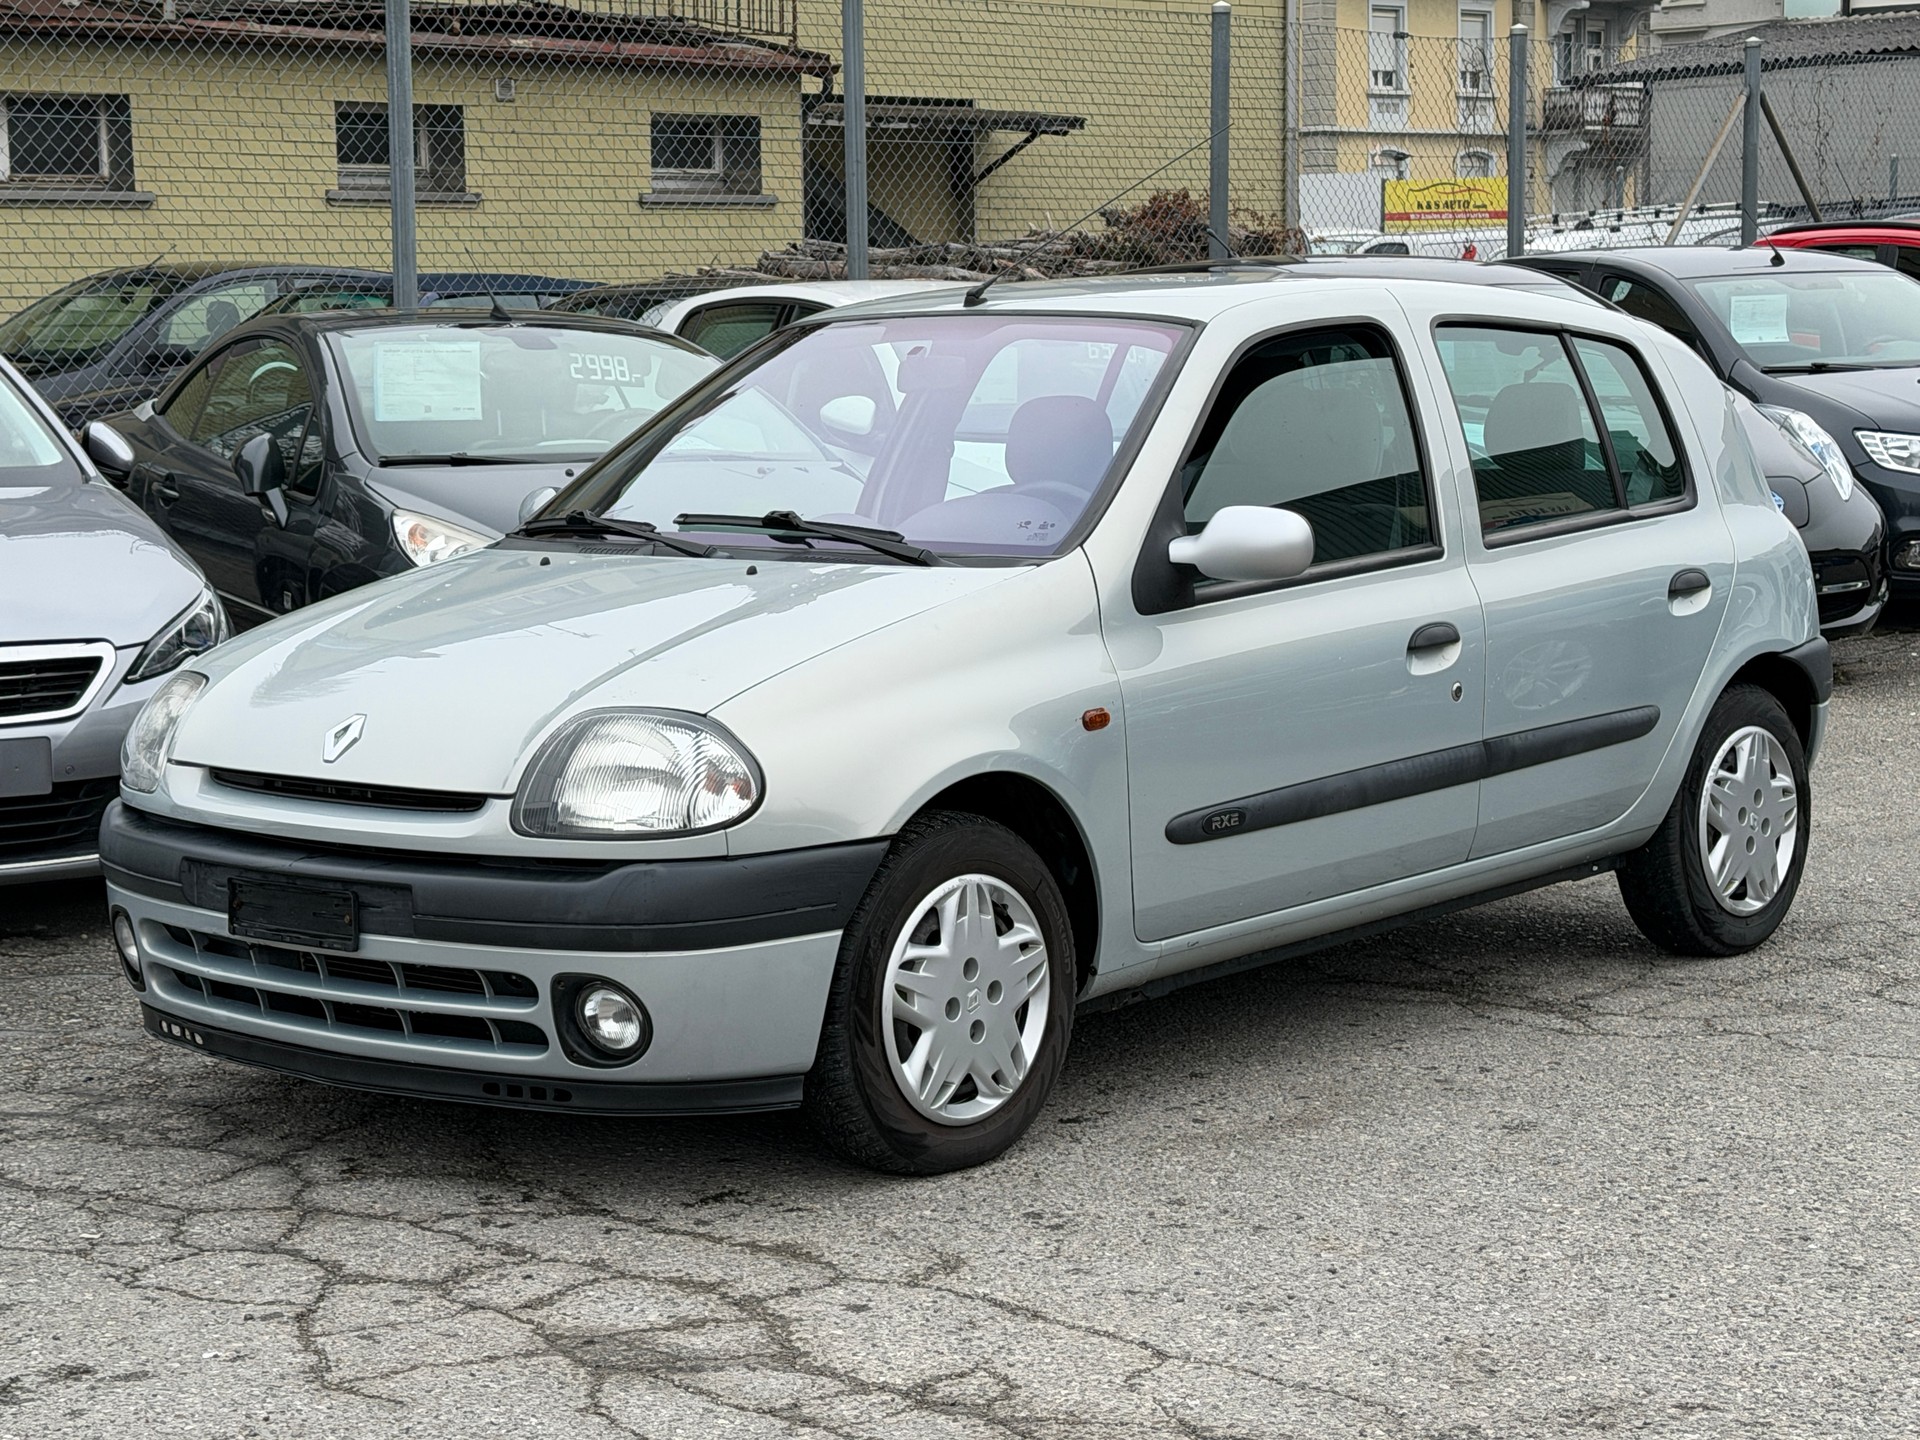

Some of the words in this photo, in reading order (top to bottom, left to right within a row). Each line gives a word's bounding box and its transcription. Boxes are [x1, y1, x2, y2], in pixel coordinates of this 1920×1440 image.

[1434, 200, 1440, 209] S
[1442, 200, 1471, 210] AUTO
[1211, 813, 1239, 830] RXE
